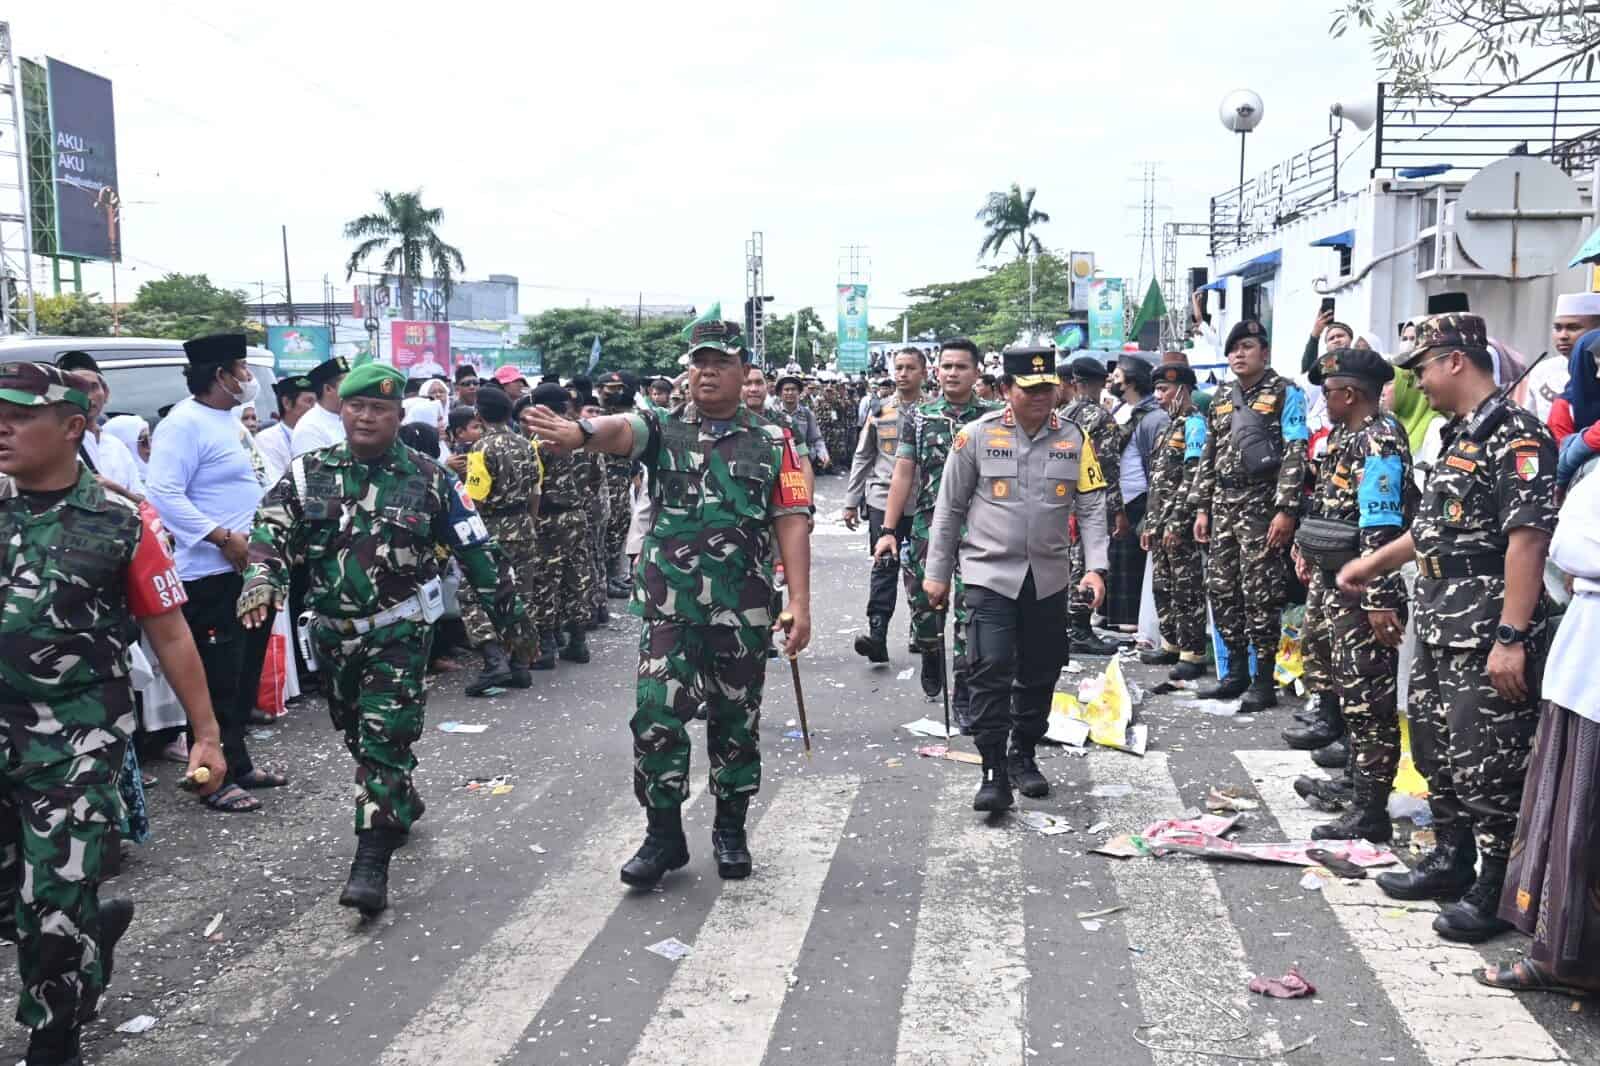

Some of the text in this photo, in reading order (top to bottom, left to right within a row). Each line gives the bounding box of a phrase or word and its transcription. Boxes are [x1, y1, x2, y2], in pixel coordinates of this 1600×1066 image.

[57, 131, 84, 152] AKU
[58, 153, 85, 173] AKU
[986, 448, 1013, 458] TONI
